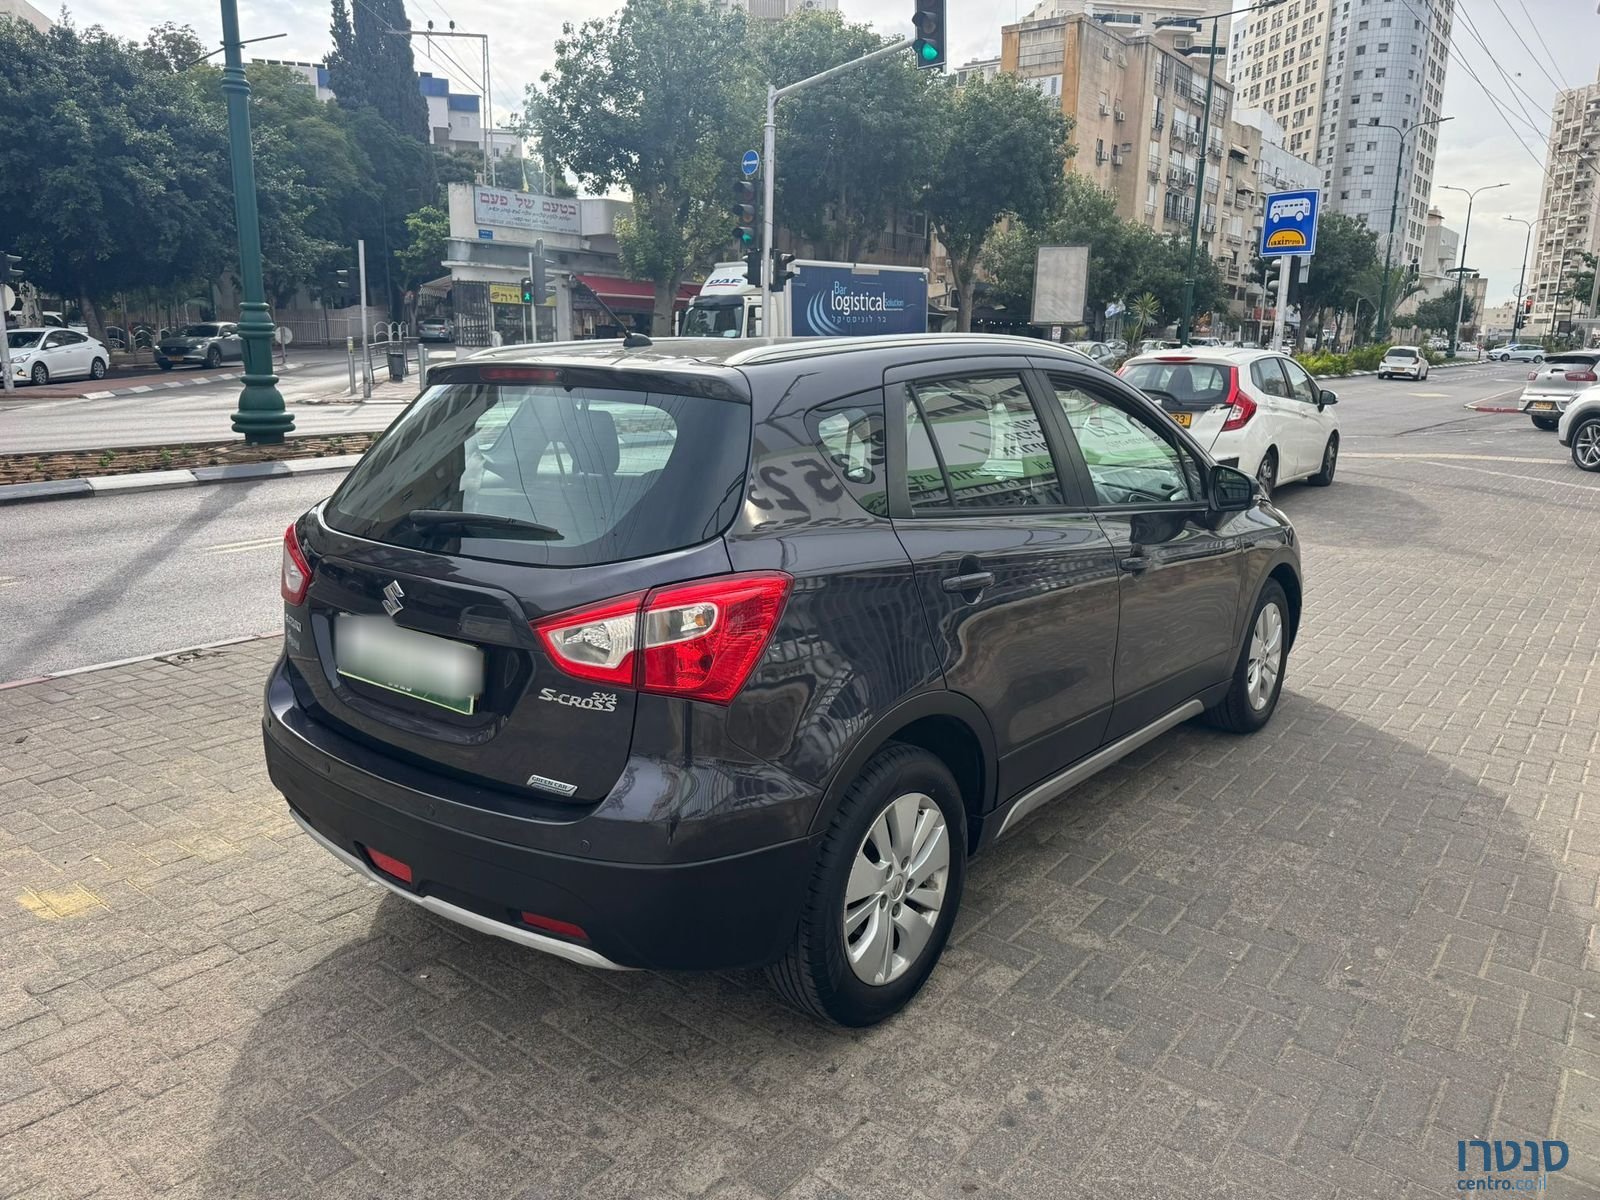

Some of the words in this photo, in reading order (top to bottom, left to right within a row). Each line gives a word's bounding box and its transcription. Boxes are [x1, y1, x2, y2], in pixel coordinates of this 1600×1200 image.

[480, 192, 508, 206] פעם
[515, 194, 535, 209] של
[542, 201, 577, 215] בטעם
[834, 280, 847, 295] Bar
[831, 290, 886, 315] logistical
[877, 315, 887, 323] בר
[591, 692, 618, 704] SX4
[532, 776, 554, 786] GREEN
[554, 782, 568, 790] CAR
